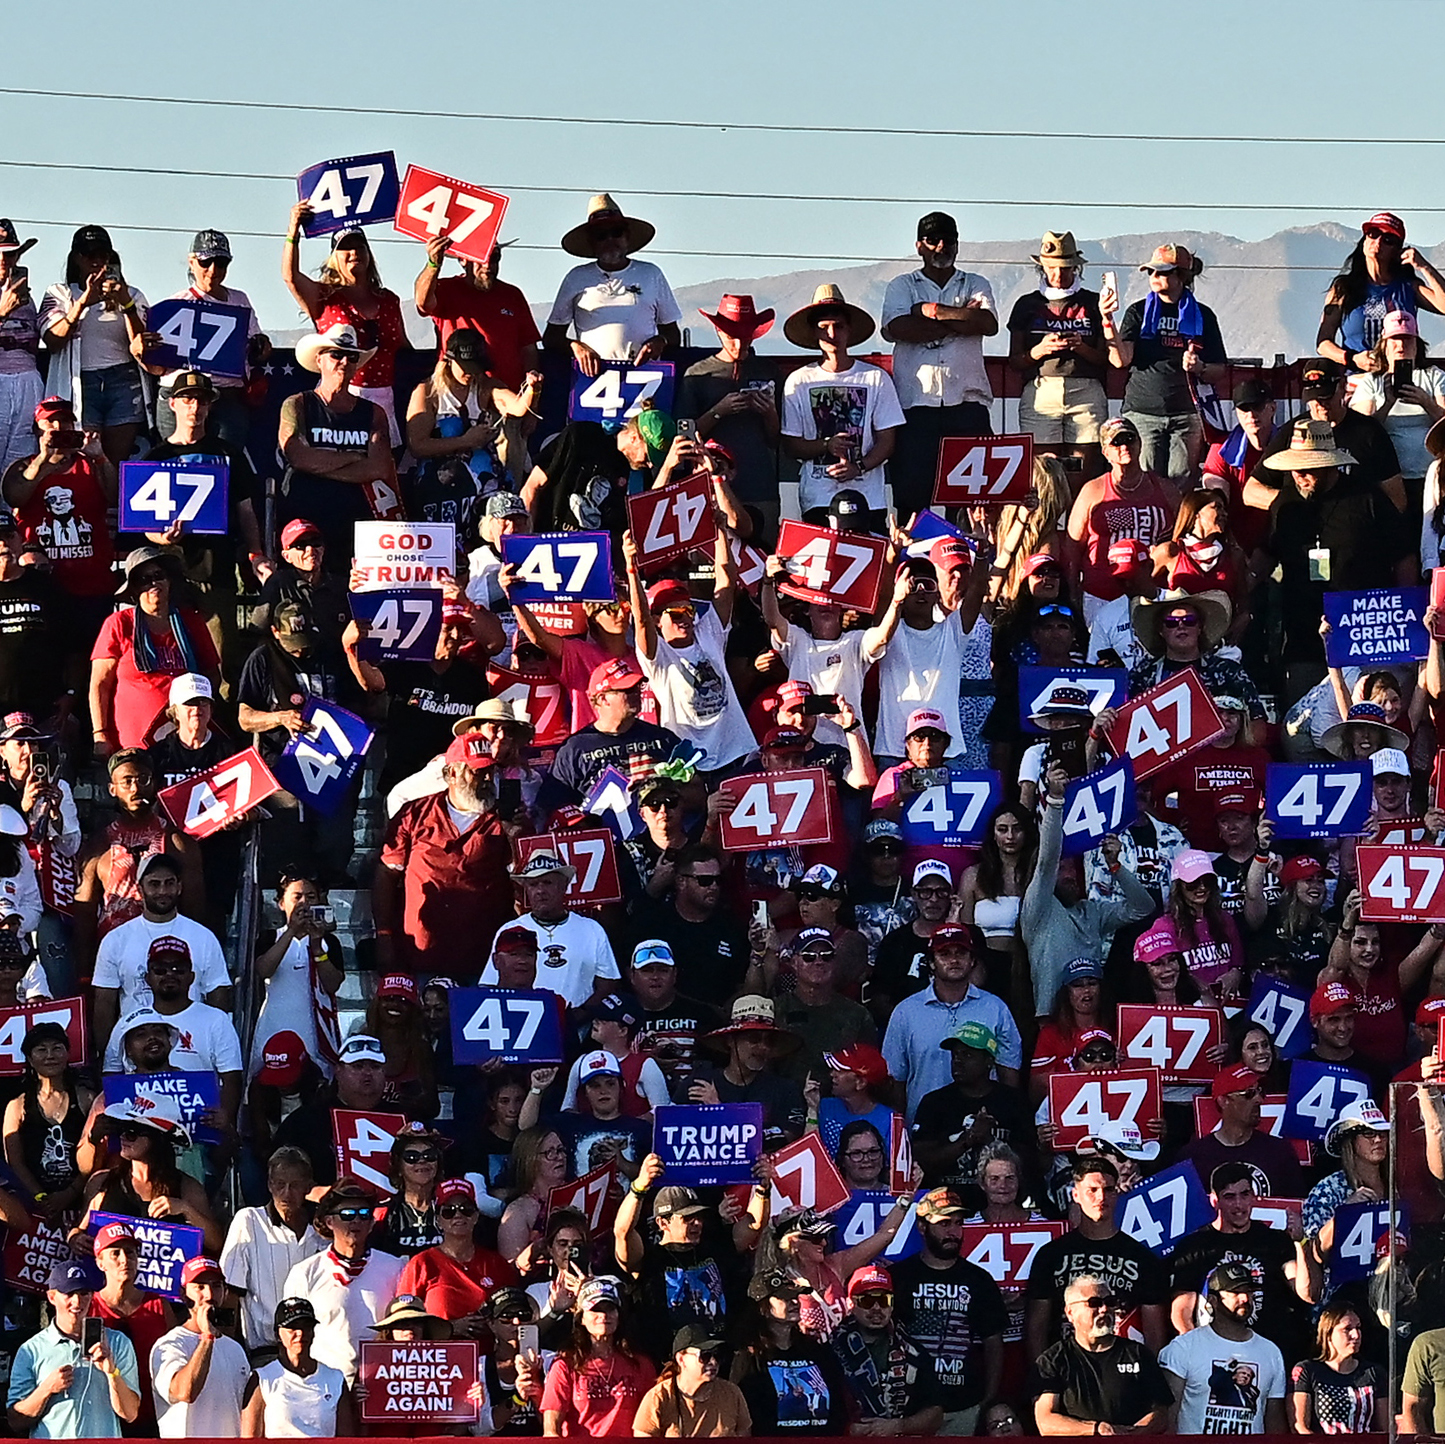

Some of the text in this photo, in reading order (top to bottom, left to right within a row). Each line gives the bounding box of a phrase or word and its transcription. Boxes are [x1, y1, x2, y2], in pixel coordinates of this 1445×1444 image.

[307, 164, 384, 218] 47
[408, 186, 494, 243] 47
[1047, 315, 1090, 329] VANCE
[157, 308, 236, 360] 47
[312, 428, 368, 444] TRUMP
[947, 446, 1023, 494] 47
[130, 472, 215, 521] 47
[644, 492, 706, 554] 47
[380, 534, 432, 550] GOD
[387, 554, 424, 563] CHOSE
[515, 542, 598, 592] 47
[1354, 596, 1402, 611] MAKE
[536, 616, 573, 629] EVER
[1340, 609, 1416, 627] AMERICA
[1350, 625, 1396, 640] GREAT
[1350, 639, 1410, 655] AGAIN!
[1125, 682, 1191, 759] 47
[295, 708, 353, 794] 47
[1198, 770, 1251, 779] AMERICA
[184, 760, 254, 835] 47
[907, 778, 990, 831] 47
[1277, 773, 1361, 825] 47
[730, 779, 814, 836] 47
[1368, 856, 1444, 909] 47
[463, 998, 544, 1050] 47
[656, 1019, 697, 1030] FIGHT
[1127, 1016, 1210, 1069] 47
[662, 1125, 756, 1144] TRUMP
[673, 1144, 746, 1160] VANCE
[1118, 1172, 1187, 1248] 47
[1054, 1254, 1138, 1280] JESUS
[912, 1284, 971, 1299] JESUS
[392, 1349, 446, 1362] MAKE
[375, 1365, 463, 1379] AMERICA
[1117, 1362, 1140, 1373] USA
[387, 1381, 452, 1395] GREAT
[385, 1397, 452, 1411] AGAIN!
[1206, 1407, 1230, 1418] FIGHT!
